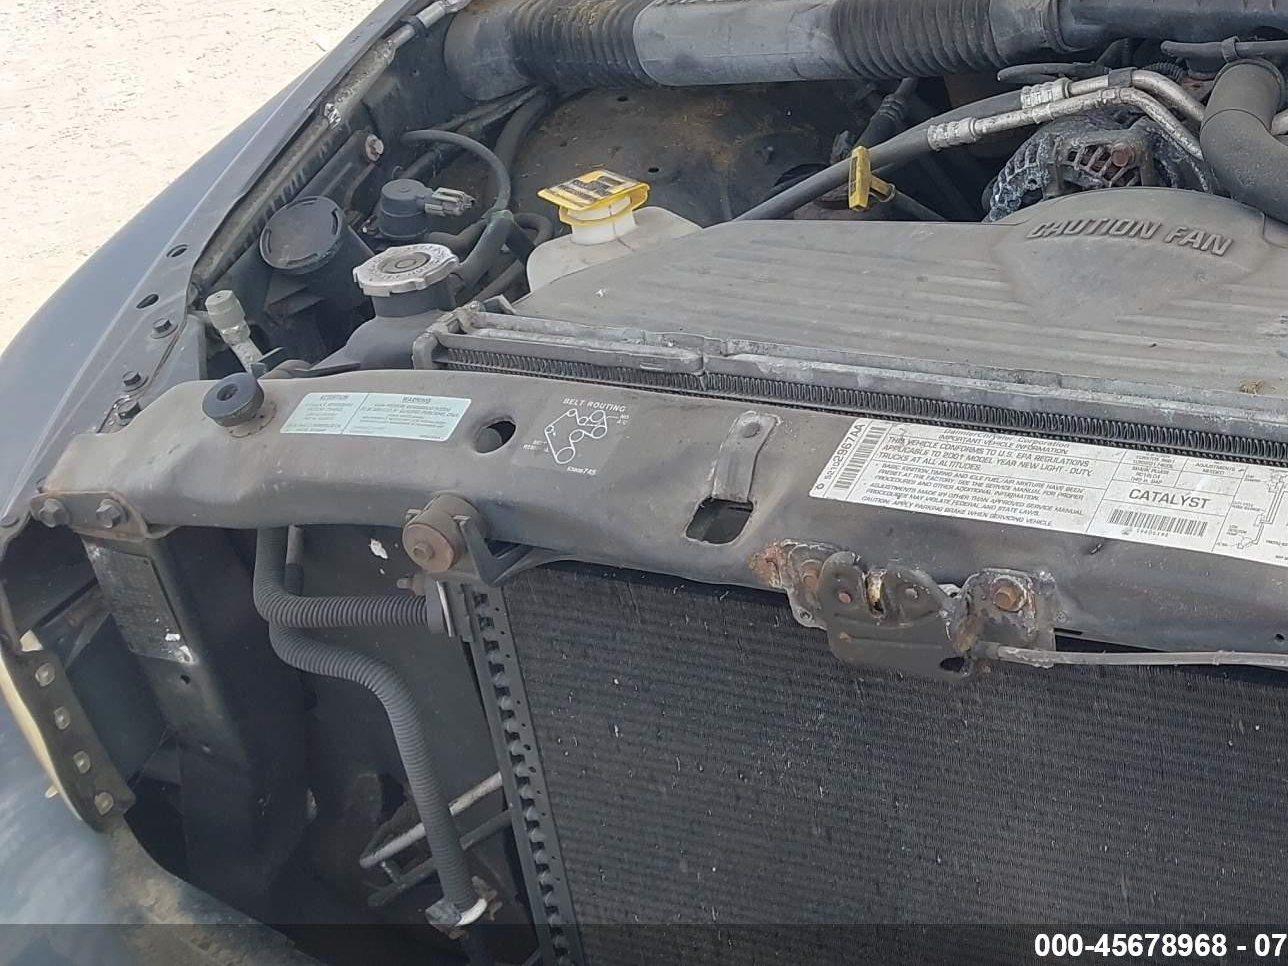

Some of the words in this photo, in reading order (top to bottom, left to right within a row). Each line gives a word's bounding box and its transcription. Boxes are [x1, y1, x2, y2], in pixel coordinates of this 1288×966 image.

[1026, 217, 1161, 240] CAUTION
[1165, 226, 1234, 257] FAN
[563, 398, 585, 406] BELT
[587, 401, 626, 412] ROUTING
[937, 434, 982, 444] IMPORTANT
[982, 439, 1014, 447] VEHICLE
[1014, 443, 1069, 454] INFORMATION
[1015, 437, 1071, 451] Corporation
[877, 452, 909, 461] TRUCKS
[906, 439, 939, 448] VEHICLE
[939, 443, 985, 453] CONFORMS
[1033, 454, 1090, 466] REGULATIONS
[881, 444, 930, 455] APPLICABLE
[965, 454, 993, 463] MODEL
[995, 458, 1017, 466] YEAR
[1017, 461, 1039, 469] NEW
[1039, 463, 1063, 472] LIGHT
[1068, 467, 1093, 476] DUTY
[1012, 486, 1042, 494] MANUAL
[1015, 480, 1045, 488] MIXTURE
[951, 499, 982, 508] FEDERAL
[1127, 488, 1211, 509] CATALYST
[913, 503, 943, 511] PARKING
[1053, 506, 1084, 515] MANUAL
